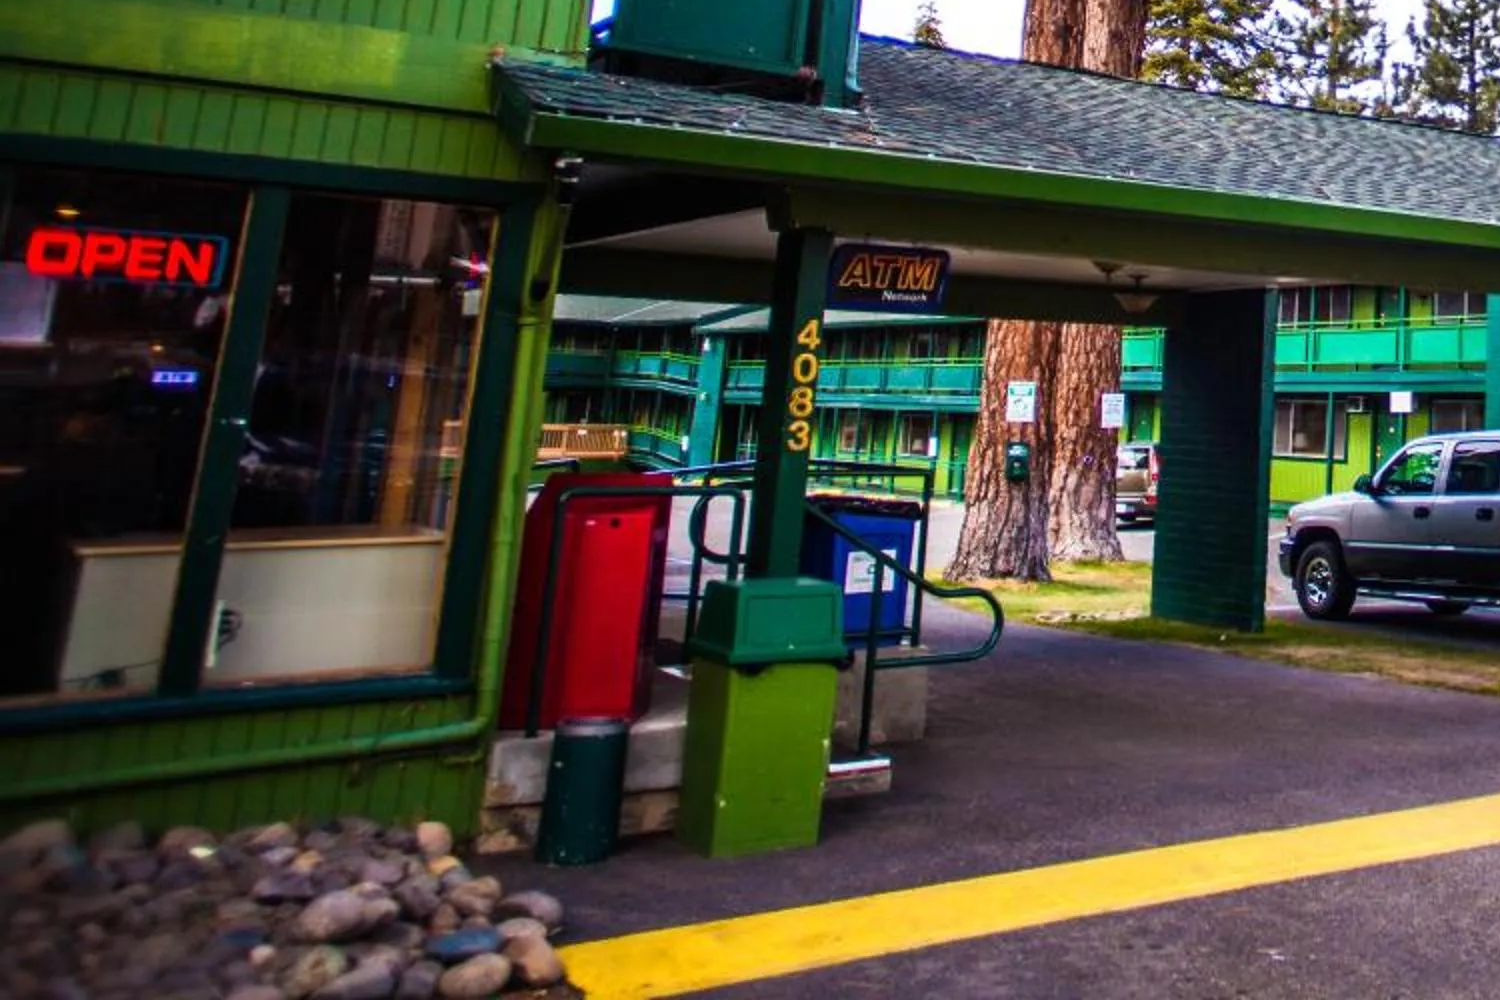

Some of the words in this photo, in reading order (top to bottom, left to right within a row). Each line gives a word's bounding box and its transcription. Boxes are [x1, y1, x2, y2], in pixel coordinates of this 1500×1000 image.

[27, 228, 215, 286] OPEN
[838, 253, 939, 291] ATM
[787, 319, 821, 451] 4083
